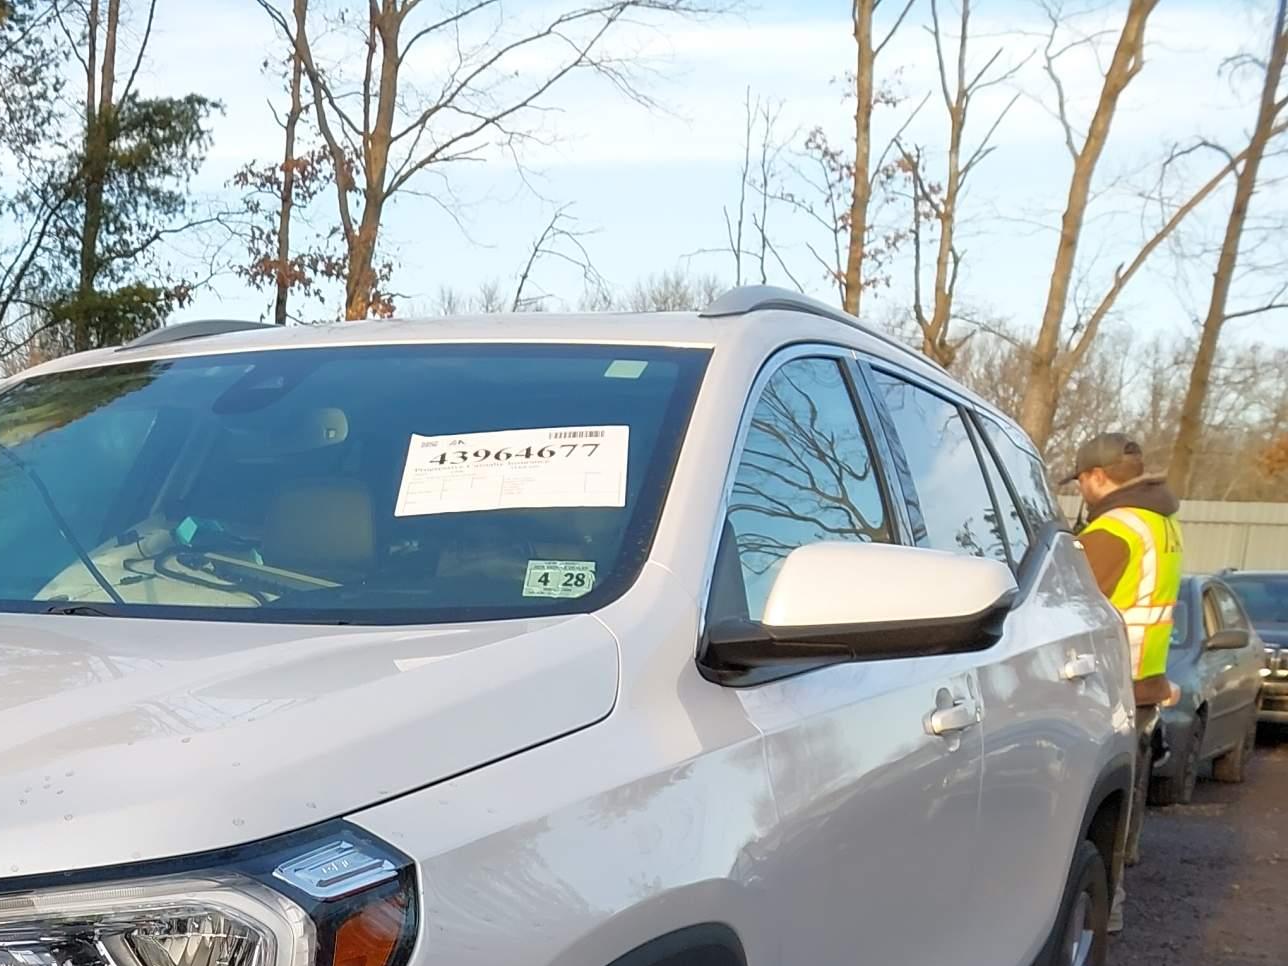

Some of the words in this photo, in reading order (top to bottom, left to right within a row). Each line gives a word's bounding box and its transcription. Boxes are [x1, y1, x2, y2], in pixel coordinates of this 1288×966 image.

[429, 443, 601, 465] 43964677
[537, 572, 550, 586] 4
[562, 572, 586, 587] 28
